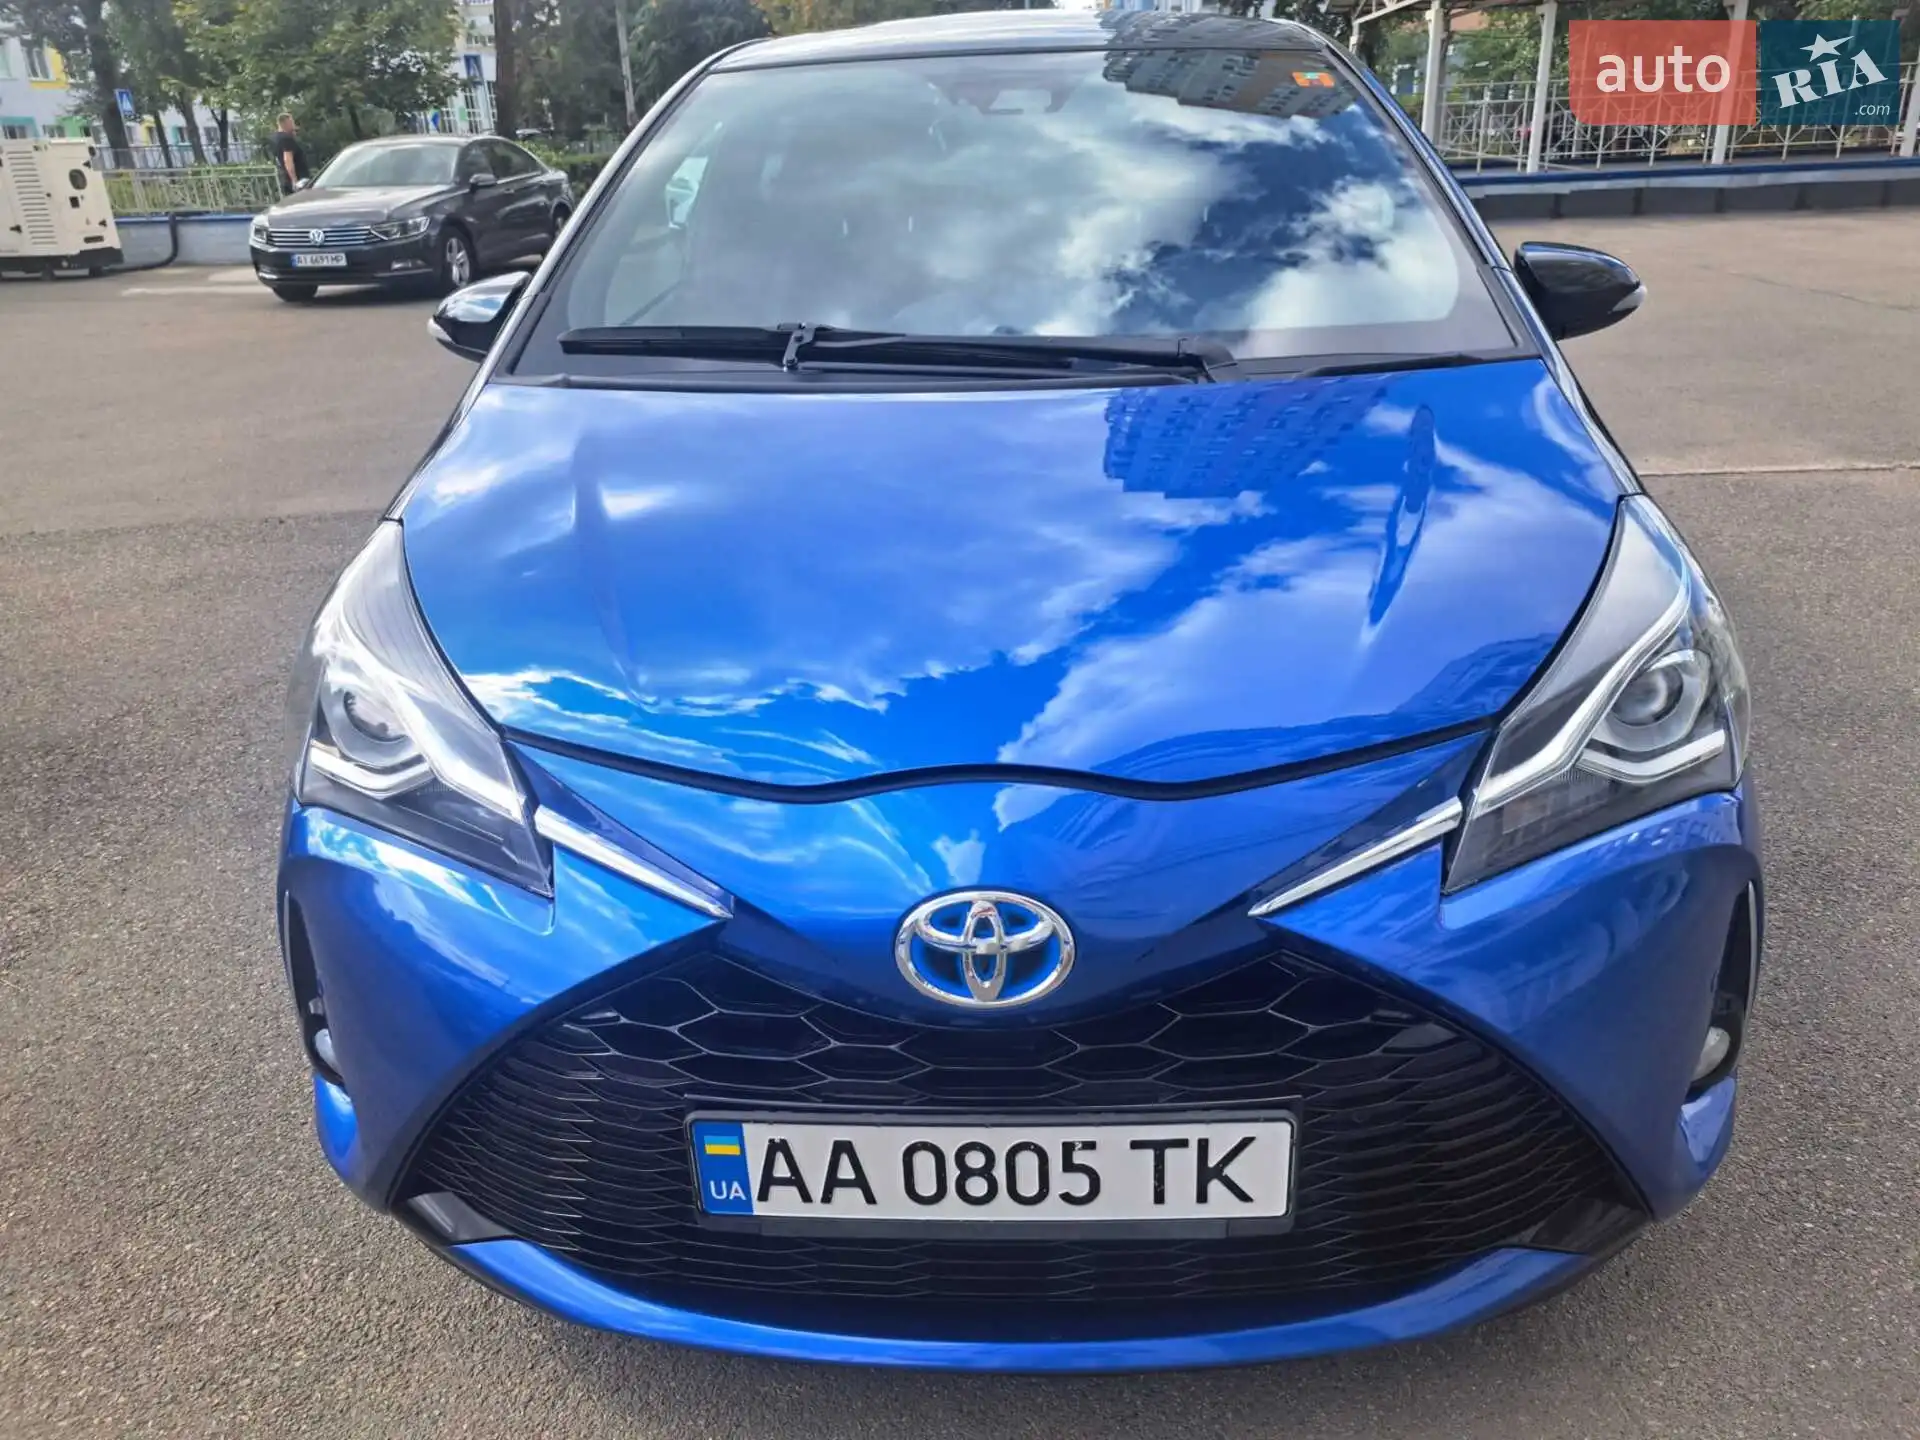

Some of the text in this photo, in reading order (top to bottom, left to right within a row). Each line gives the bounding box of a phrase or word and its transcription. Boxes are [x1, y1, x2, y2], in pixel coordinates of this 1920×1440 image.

[710, 1180, 746, 1200] UA
[757, 1136, 1256, 1206] AA 0805 TK
